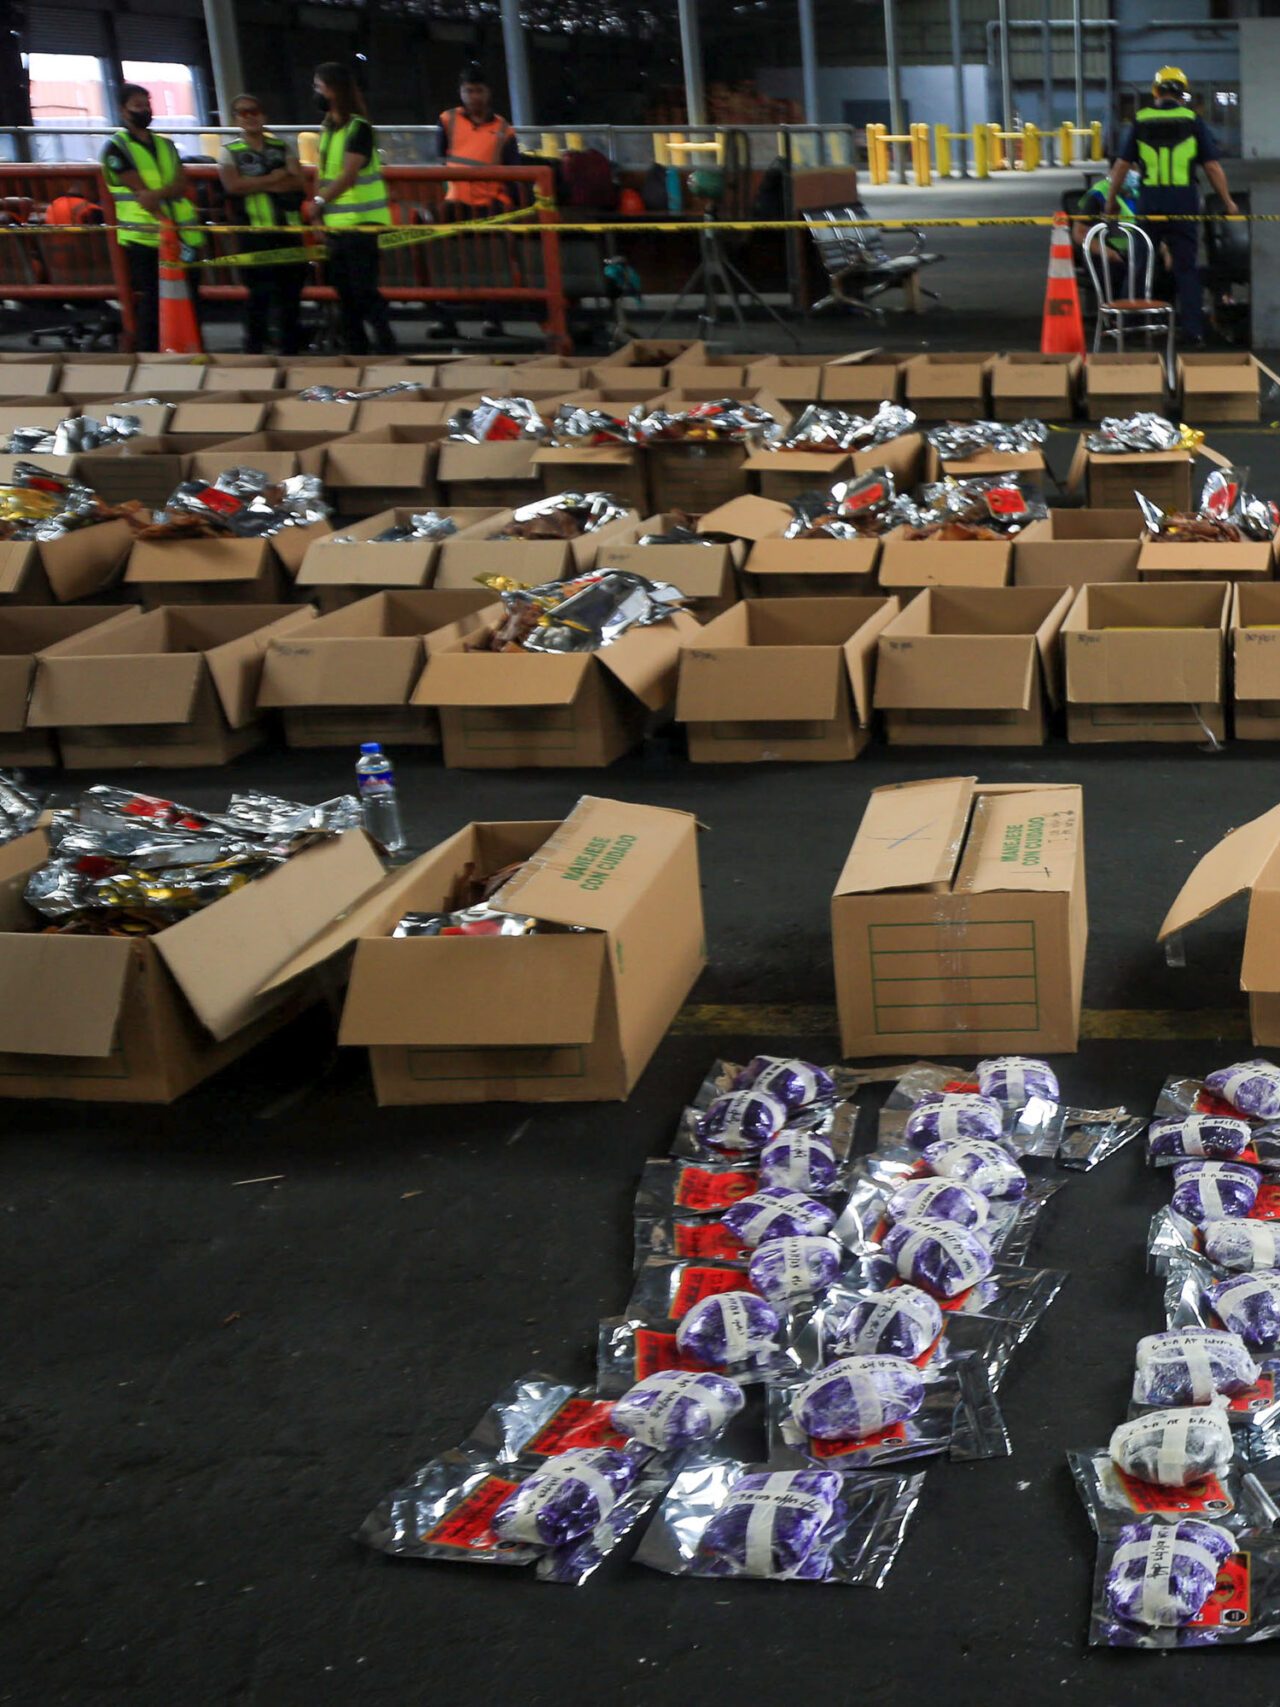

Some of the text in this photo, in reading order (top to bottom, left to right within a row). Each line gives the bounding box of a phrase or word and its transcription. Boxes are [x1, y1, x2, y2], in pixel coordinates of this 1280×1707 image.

[561, 836, 611, 881] MANEJESE
[580, 834, 637, 891] CON CUIDADO
[1000, 824, 1024, 862] MANEJESE
[1022, 816, 1045, 866] CON CUIDADO
